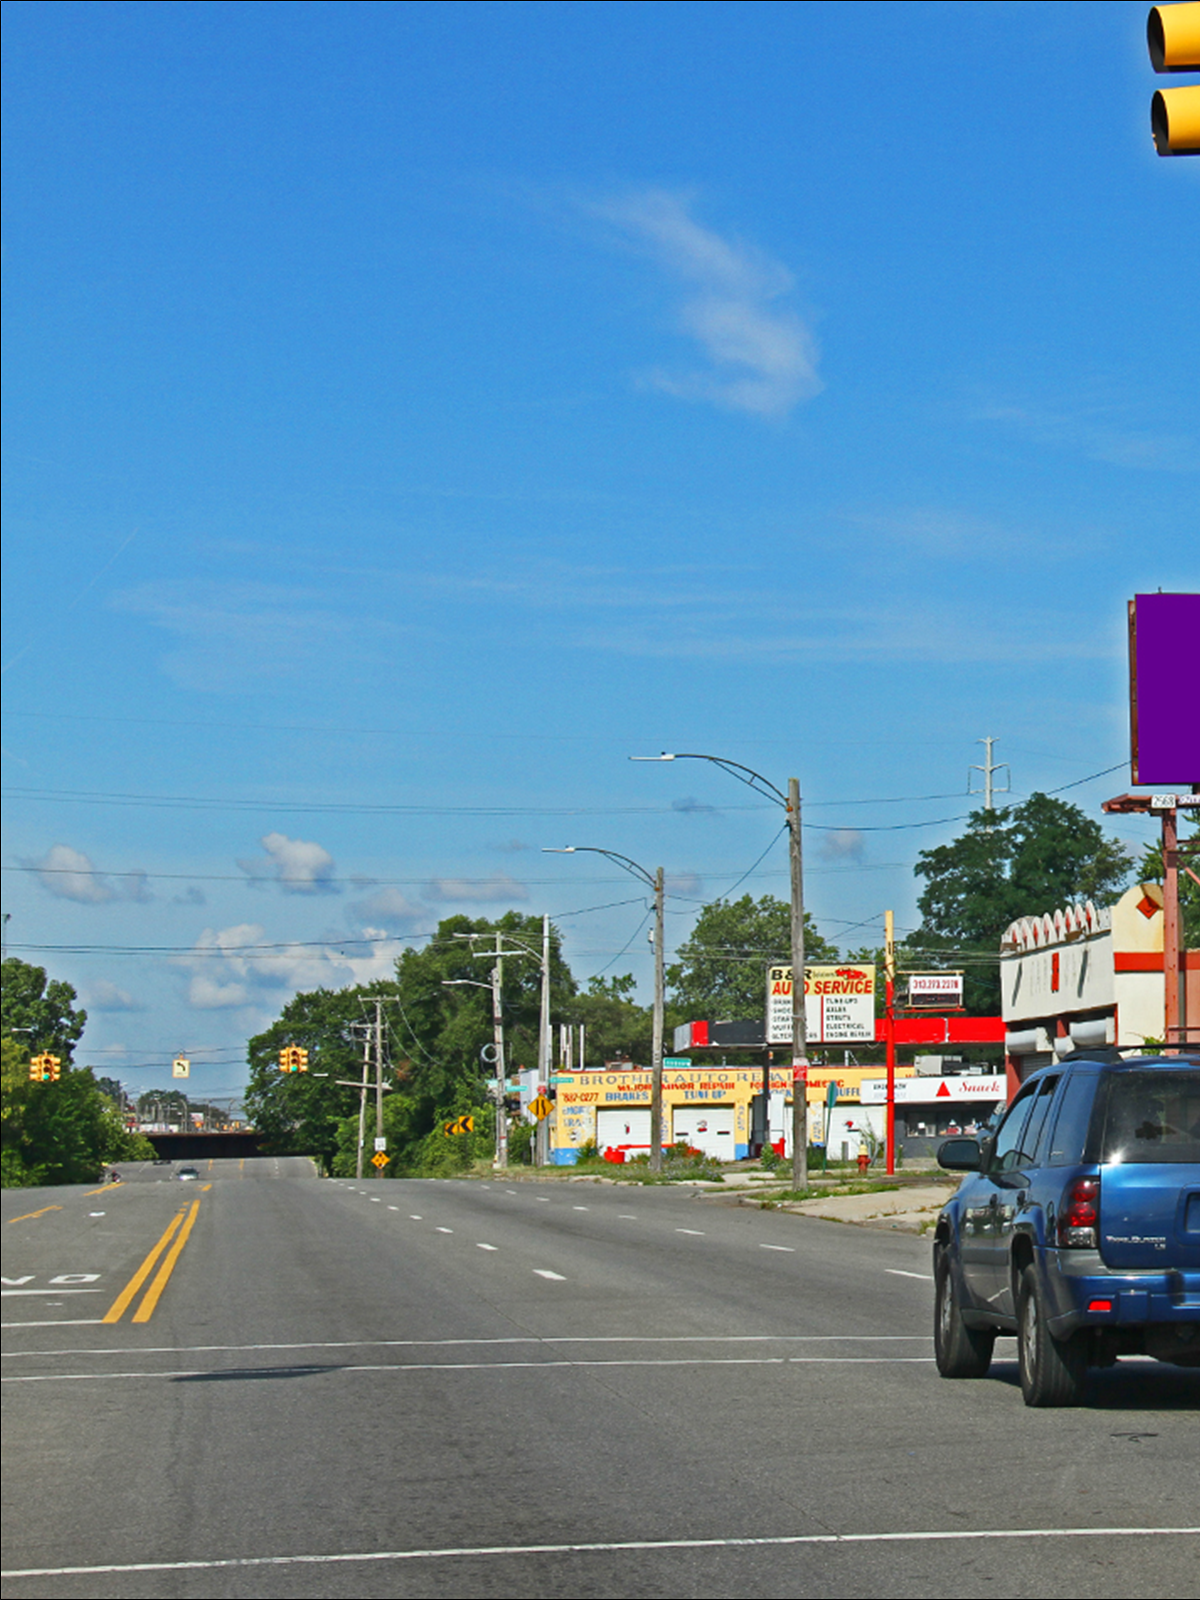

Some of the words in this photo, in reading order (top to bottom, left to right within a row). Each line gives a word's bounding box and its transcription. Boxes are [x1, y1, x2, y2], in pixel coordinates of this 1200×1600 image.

[772, 981, 810, 995] AUO
[814, 980, 873, 995] SERVICE
[674, 1073, 729, 1082] AUTO
[958, 1081, 1000, 1092] Snack
[605, 1091, 649, 1101] BRAKES
